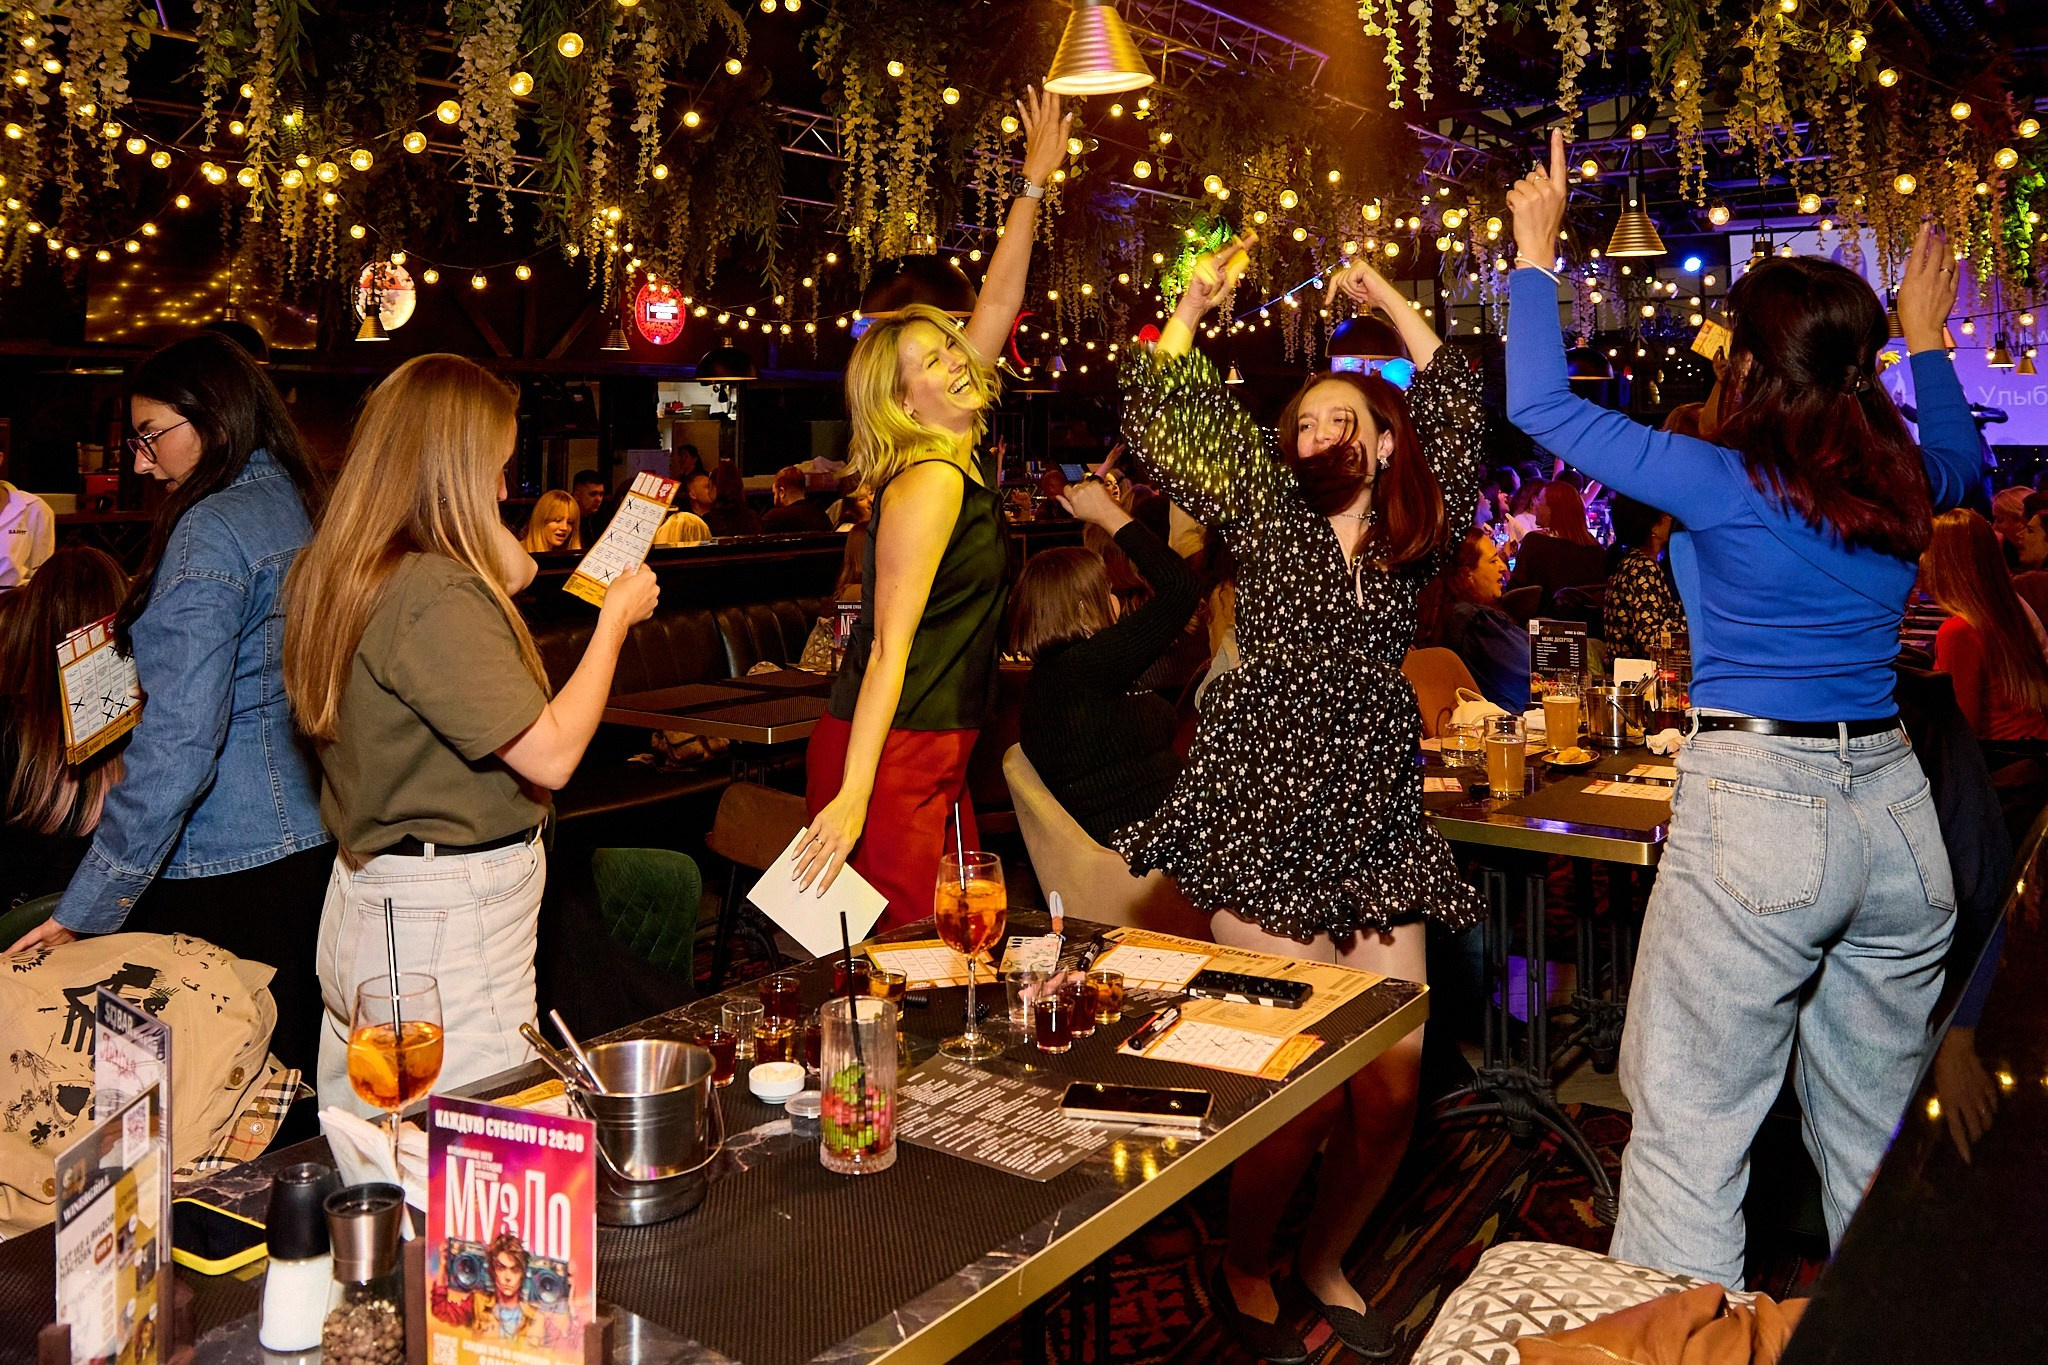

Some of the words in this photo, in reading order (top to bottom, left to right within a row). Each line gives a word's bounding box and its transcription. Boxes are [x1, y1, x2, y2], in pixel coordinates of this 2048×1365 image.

[1978, 385, 2048, 405] Улыб
[435, 1109, 484, 1135] КАЖДУЮ
[486, 1118, 537, 1144] СУББОТУ
[538, 1127, 547, 1146] В
[548, 1129, 584, 1153] 20:00
